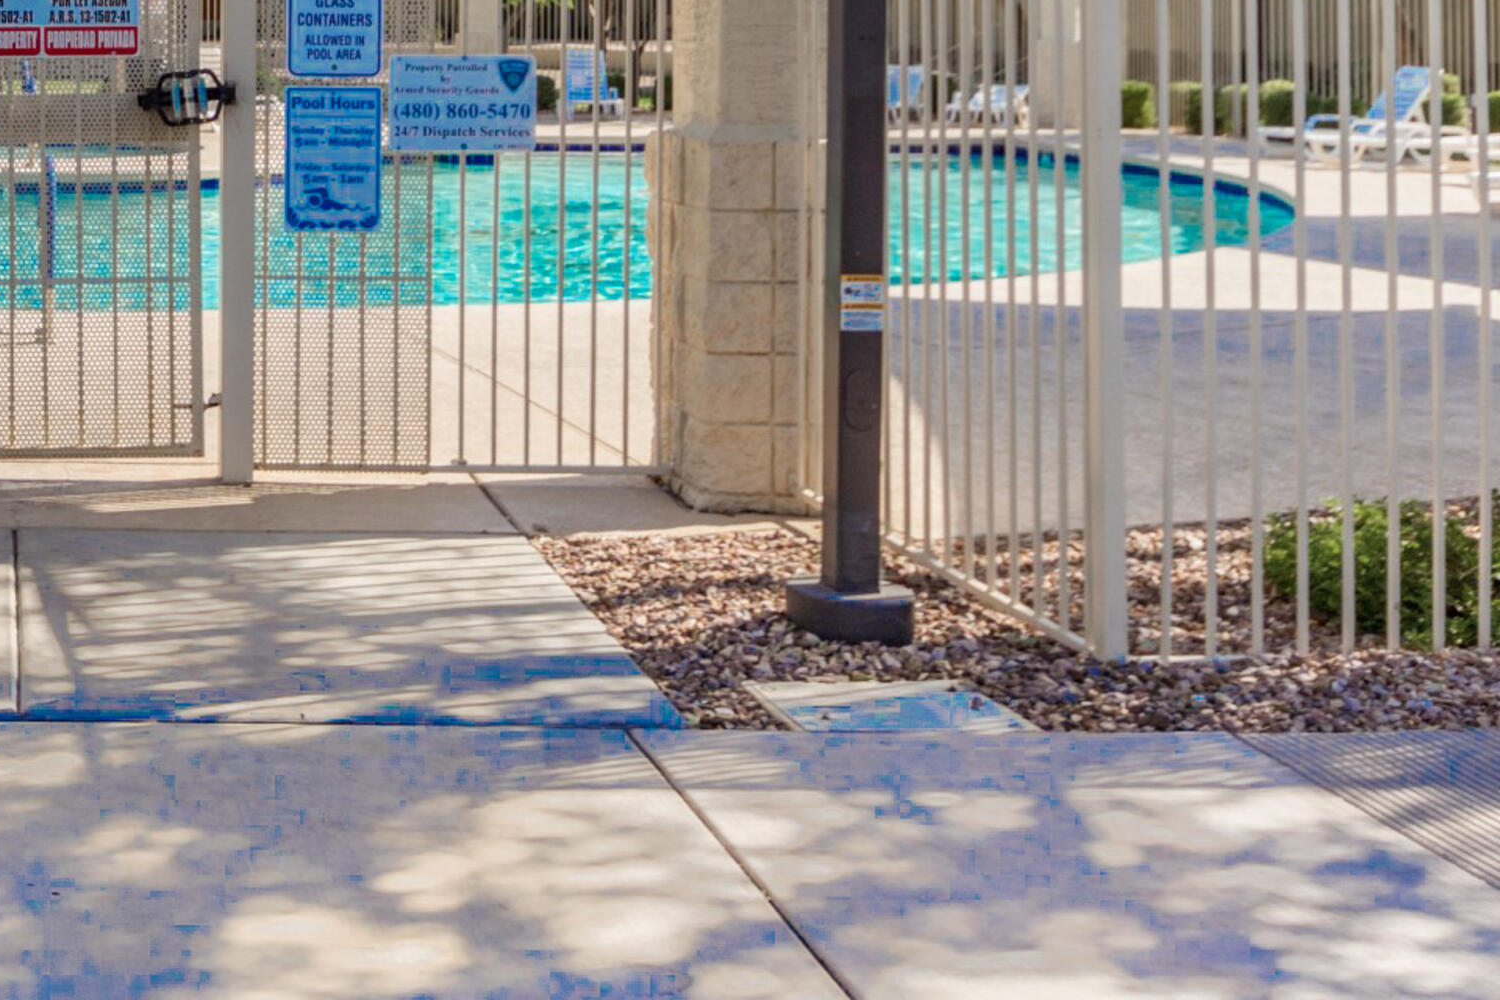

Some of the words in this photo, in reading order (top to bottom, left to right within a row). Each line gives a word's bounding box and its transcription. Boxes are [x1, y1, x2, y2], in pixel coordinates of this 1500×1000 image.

[50, 11, 77, 23] A.R.S.
[80, 11, 130, 23] 13-1502-A1
[298, 13, 373, 27] CONTAINERS
[47, 31, 96, 49] PROPIEDAD
[99, 31, 135, 49] PRIVADA
[305, 35, 352, 46] ALLOWED
[355, 35, 365, 46] IN
[307, 49, 333, 60] POOL
[336, 49, 362, 60] AREA
[405, 64, 443, 72] Property
[447, 64, 488, 72] Patrolled
[394, 86, 423, 94] Armed
[427, 86, 462, 94] Security
[466, 86, 499, 94] Guards
[292, 97, 325, 109] Pool
[330, 97, 375, 109] Hours
[394, 103, 440, 120] (480)
[446, 103, 531, 119] 860-5470
[292, 126, 325, 135] Sunday
[333, 126, 375, 135] Thursday
[394, 126, 419, 137] 24/7
[423, 126, 476, 139] Dispatch
[479, 126, 531, 137] Services
[328, 138, 372, 147] Midnight
[294, 163, 324, 172] Friday
[332, 163, 370, 172] Saturday
[303, 175, 328, 184] 5am
[340, 175, 363, 184] 1am
